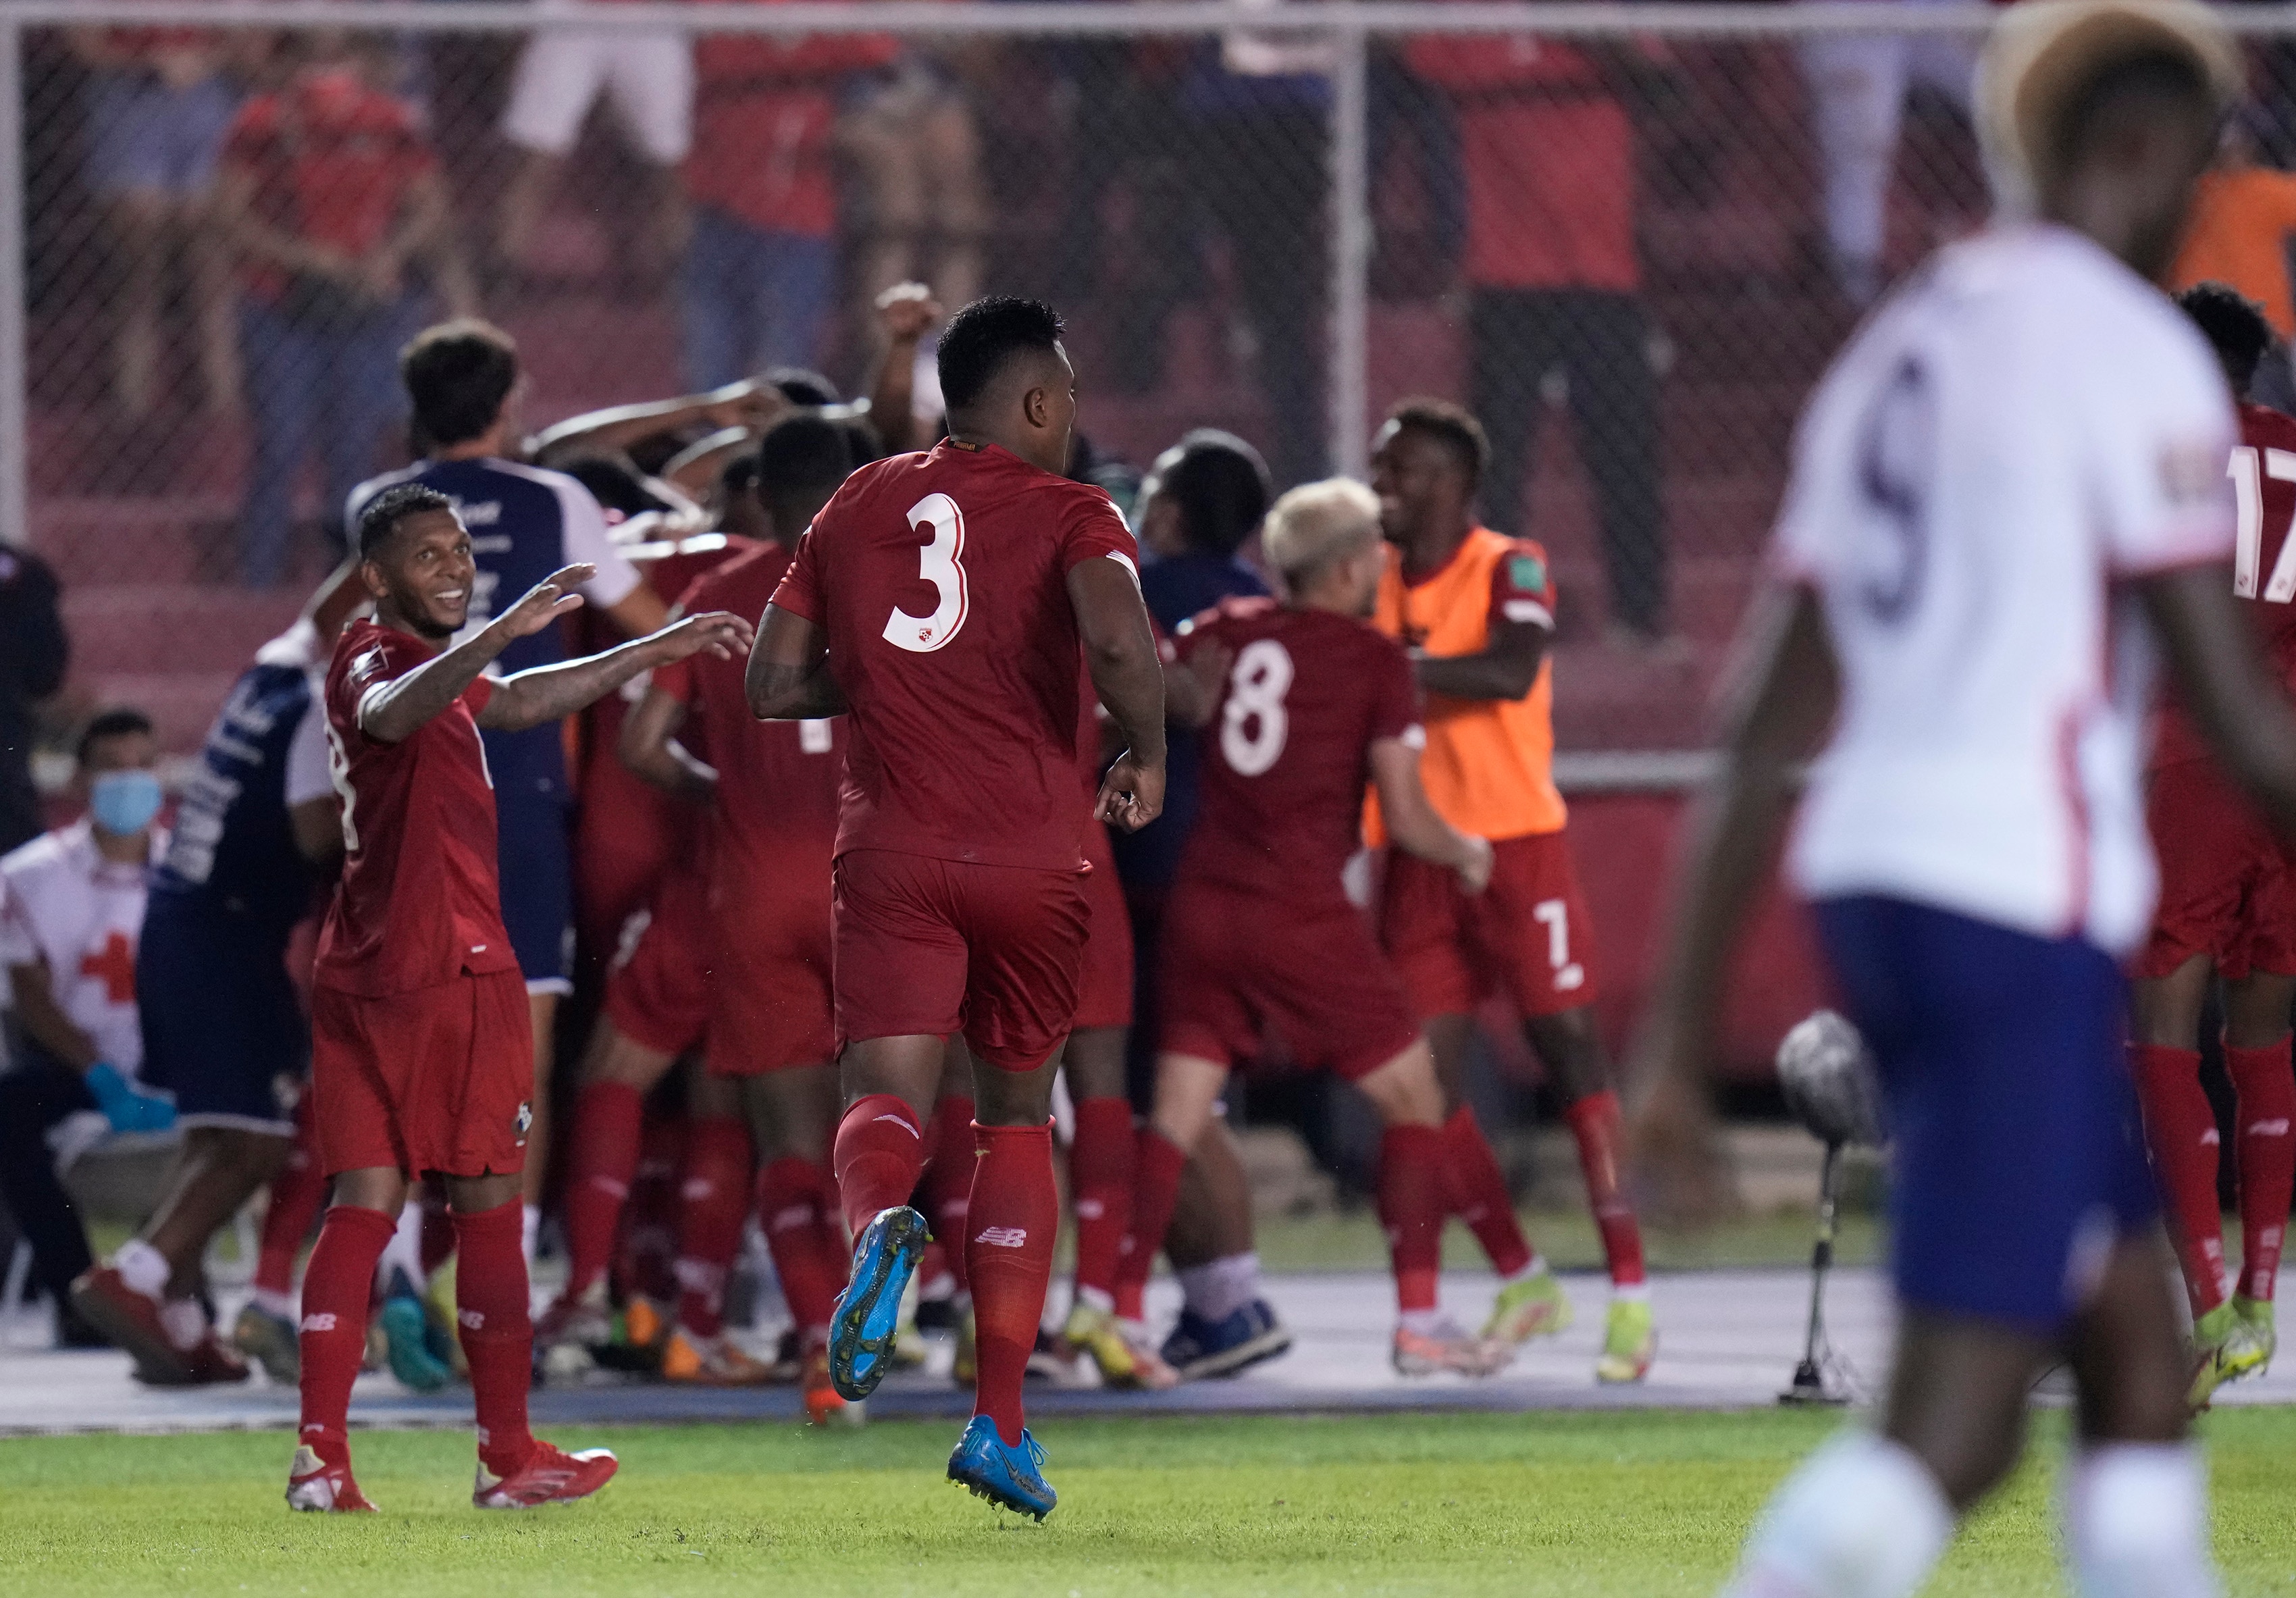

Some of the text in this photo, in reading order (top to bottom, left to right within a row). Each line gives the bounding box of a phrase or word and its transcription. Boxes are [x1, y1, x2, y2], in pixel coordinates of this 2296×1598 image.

[882, 492, 969, 652] 3
[2226, 445, 2296, 604] 17
[1220, 638, 1295, 777] 8
